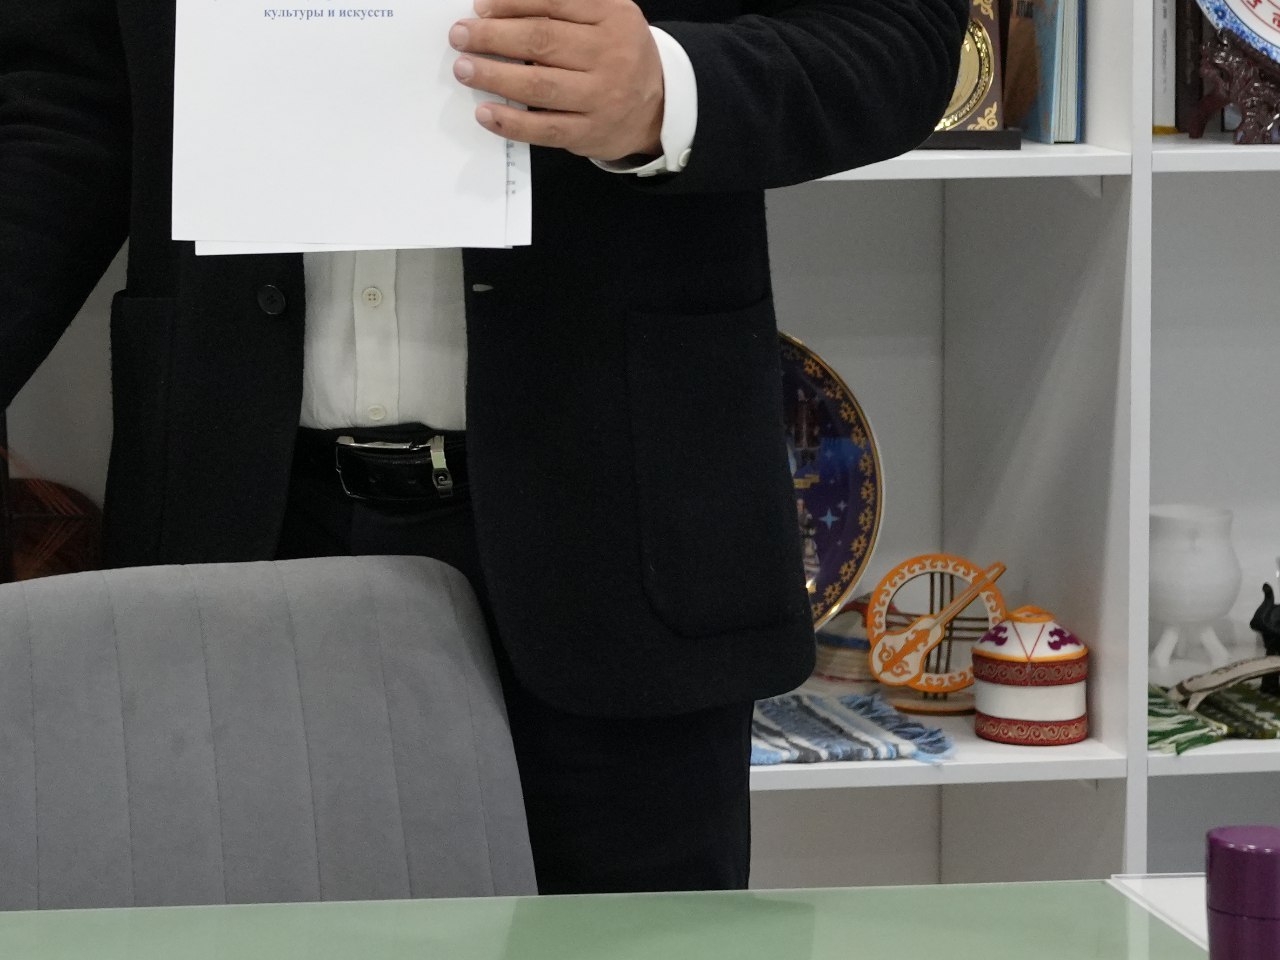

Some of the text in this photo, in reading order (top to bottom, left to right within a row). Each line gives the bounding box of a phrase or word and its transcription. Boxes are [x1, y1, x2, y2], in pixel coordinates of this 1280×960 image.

[264, 7, 394, 19] культуры и искусств
